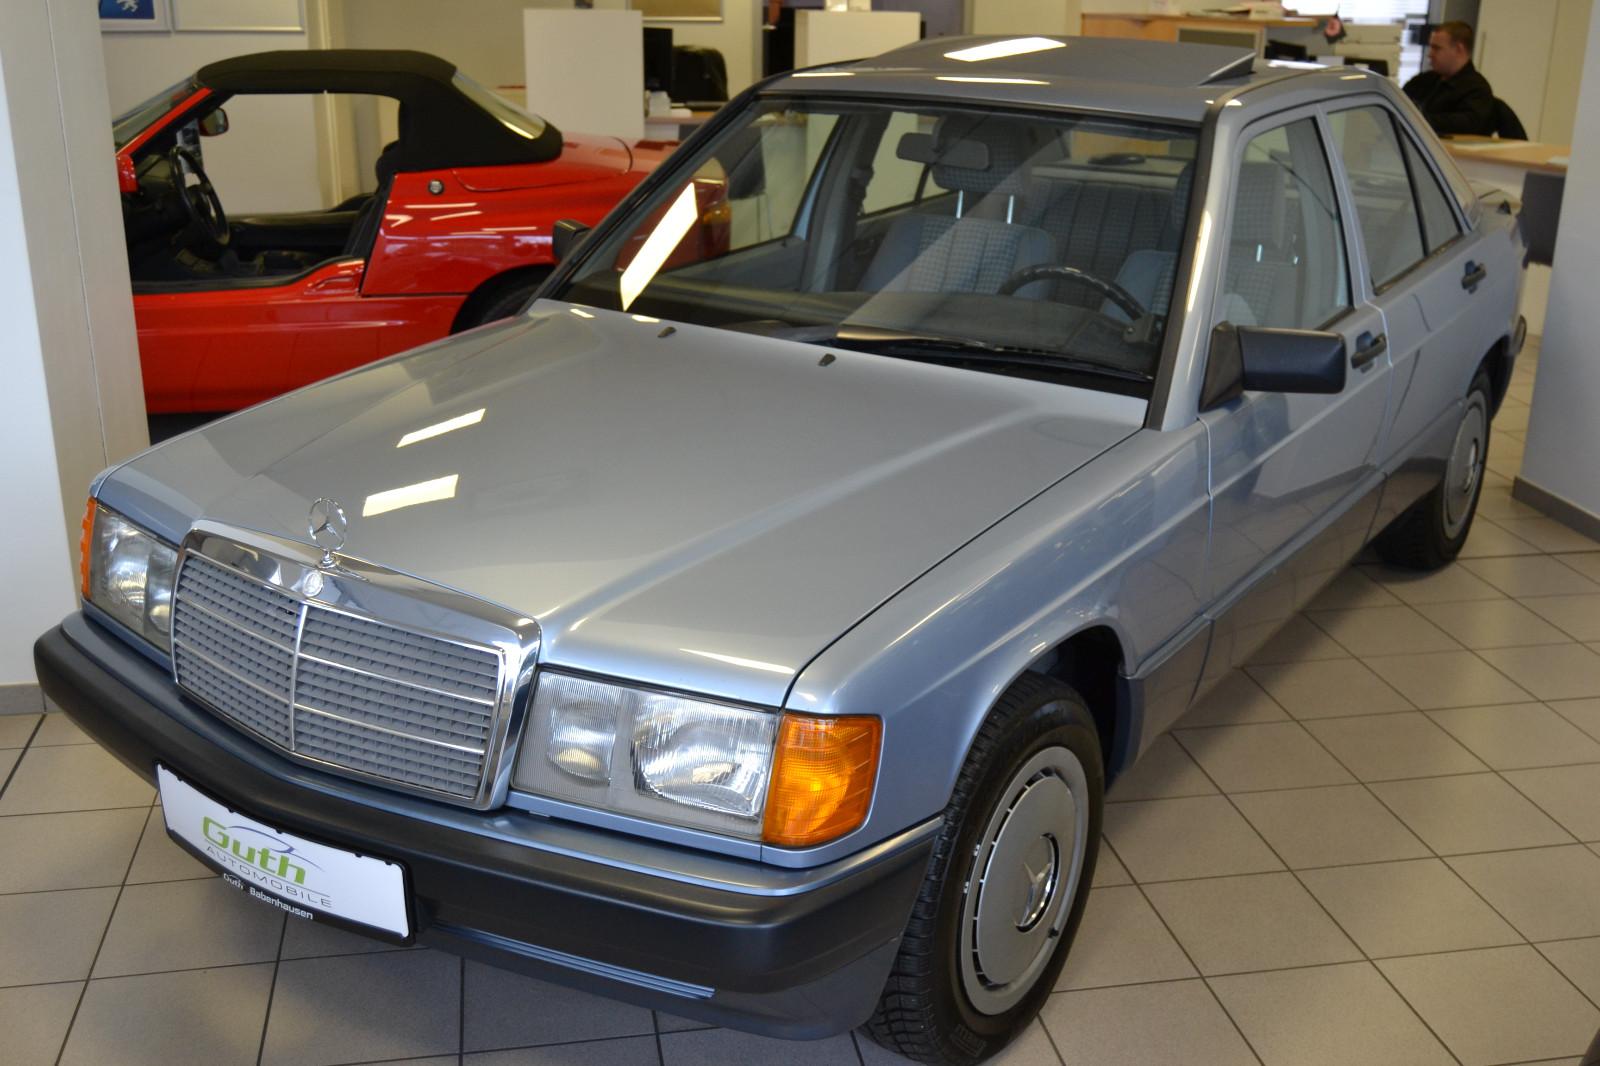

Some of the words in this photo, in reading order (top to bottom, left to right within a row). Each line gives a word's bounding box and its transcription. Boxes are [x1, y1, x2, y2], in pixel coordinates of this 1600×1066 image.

[203, 817, 306, 885] Guth
[206, 845, 332, 908] AUTOMOBILE
[249, 886, 314, 920] Babenhausen
